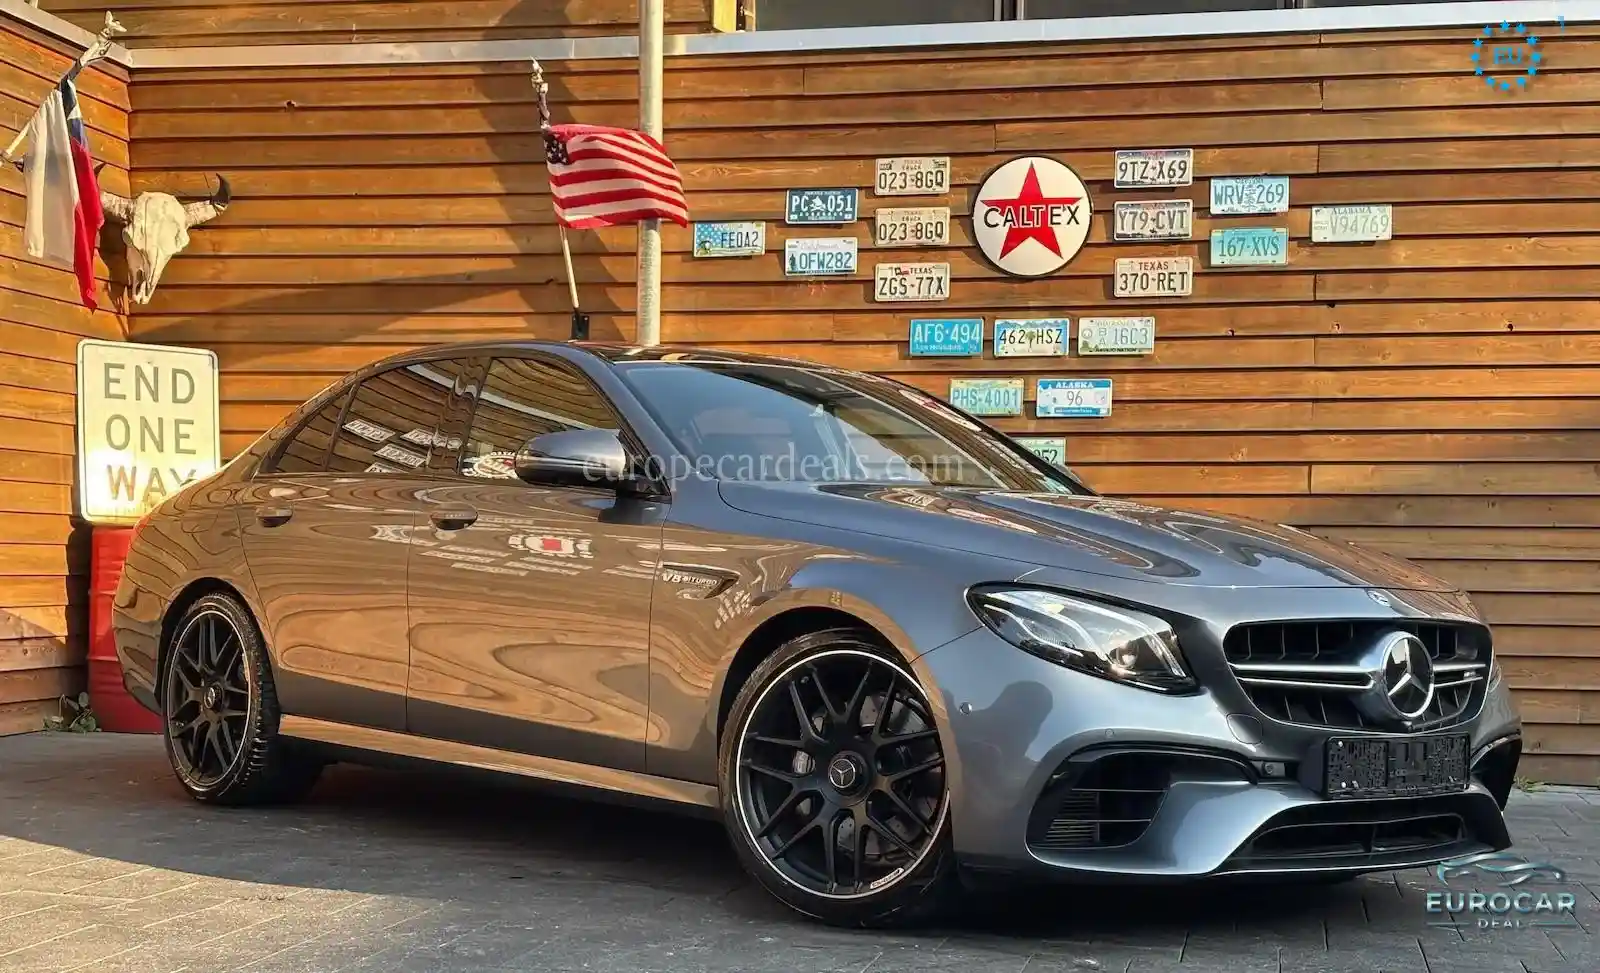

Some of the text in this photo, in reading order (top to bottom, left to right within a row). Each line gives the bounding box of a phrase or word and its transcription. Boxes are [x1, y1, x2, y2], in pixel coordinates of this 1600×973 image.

[1214, 183, 1285, 205] WRV 269
[827, 195, 853, 212] 051
[983, 203, 1080, 228] CALTEX
[1137, 261, 1169, 271] TEXAS
[999, 328, 1063, 345] 462 HSZ
[104, 362, 195, 404] END
[1066, 391, 1083, 406] 96
[105, 413, 196, 455] ONE
[662, 572, 682, 584] V8
